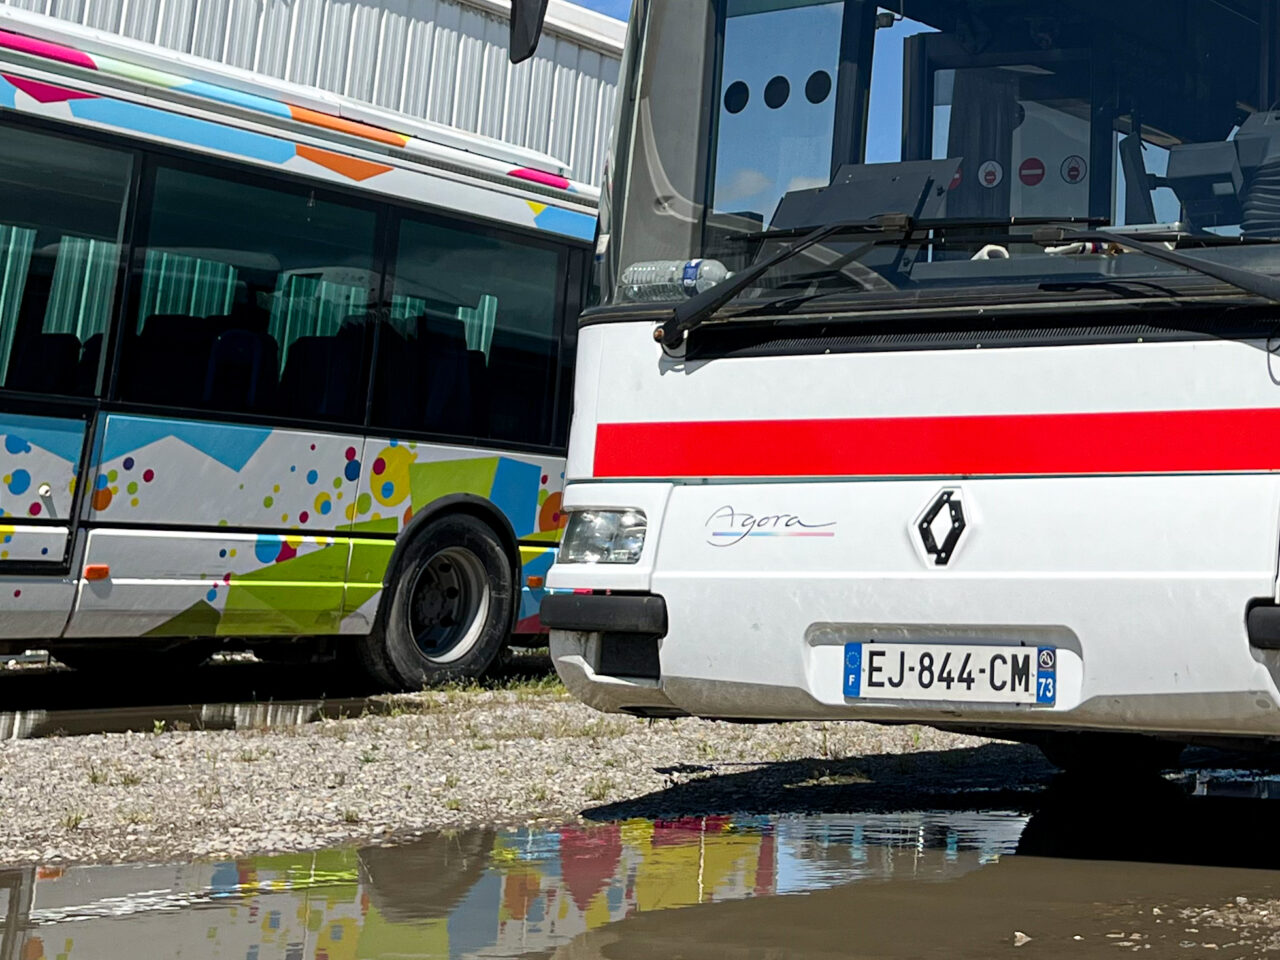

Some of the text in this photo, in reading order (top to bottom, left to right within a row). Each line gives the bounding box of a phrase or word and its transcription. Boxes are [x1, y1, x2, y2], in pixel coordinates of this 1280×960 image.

[705, 505, 837, 547] Agora
[848, 650, 1054, 698] F EJ-844-CM 73
